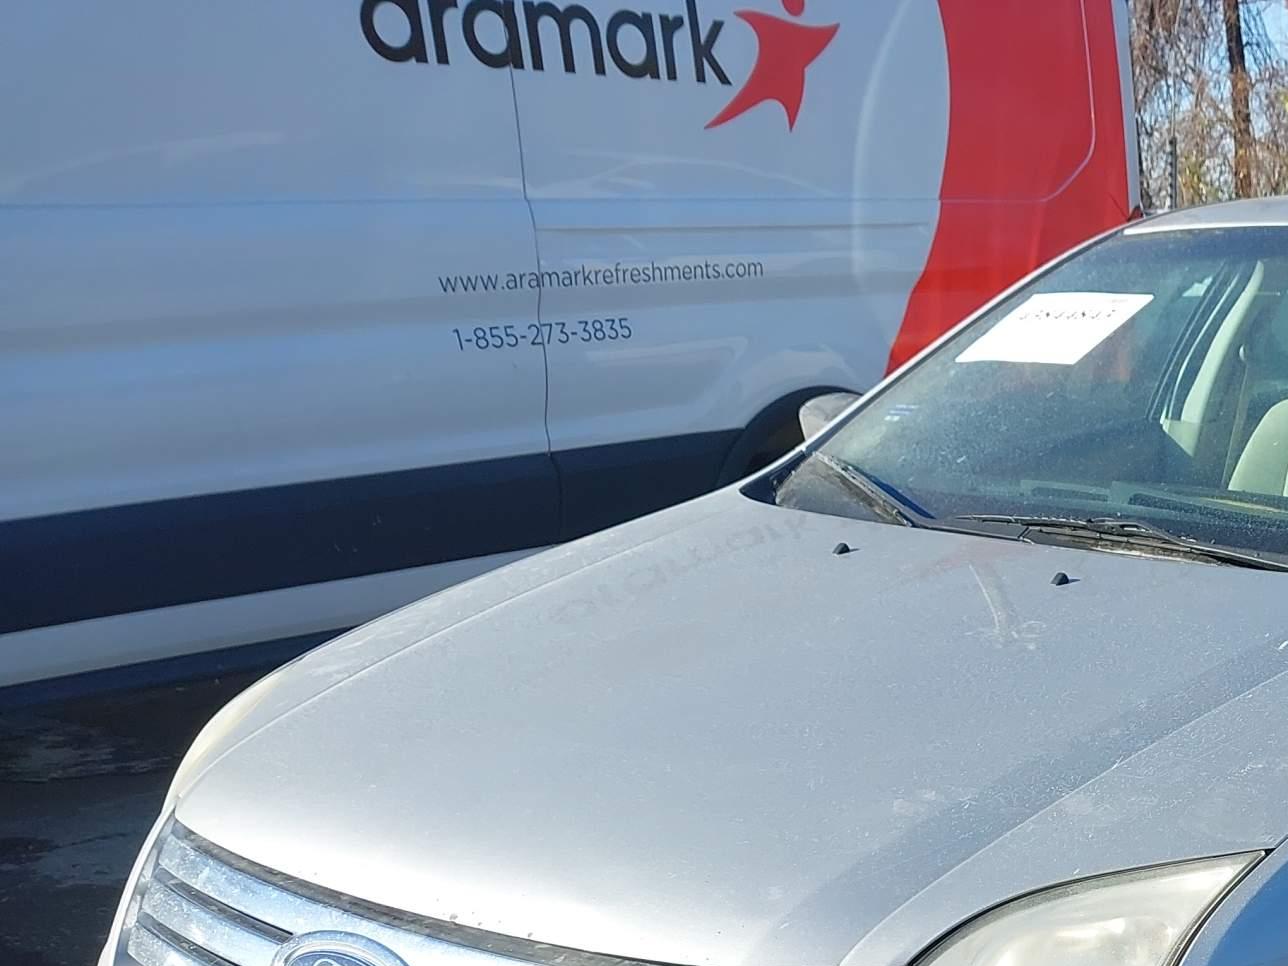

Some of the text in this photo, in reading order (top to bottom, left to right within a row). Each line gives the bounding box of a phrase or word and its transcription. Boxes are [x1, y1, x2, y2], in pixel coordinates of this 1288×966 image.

[360, 0, 732, 86] aramark
[438, 260, 765, 294] www.aramarkrefreshments.com
[452, 317, 633, 351] 1-855-273-3835
